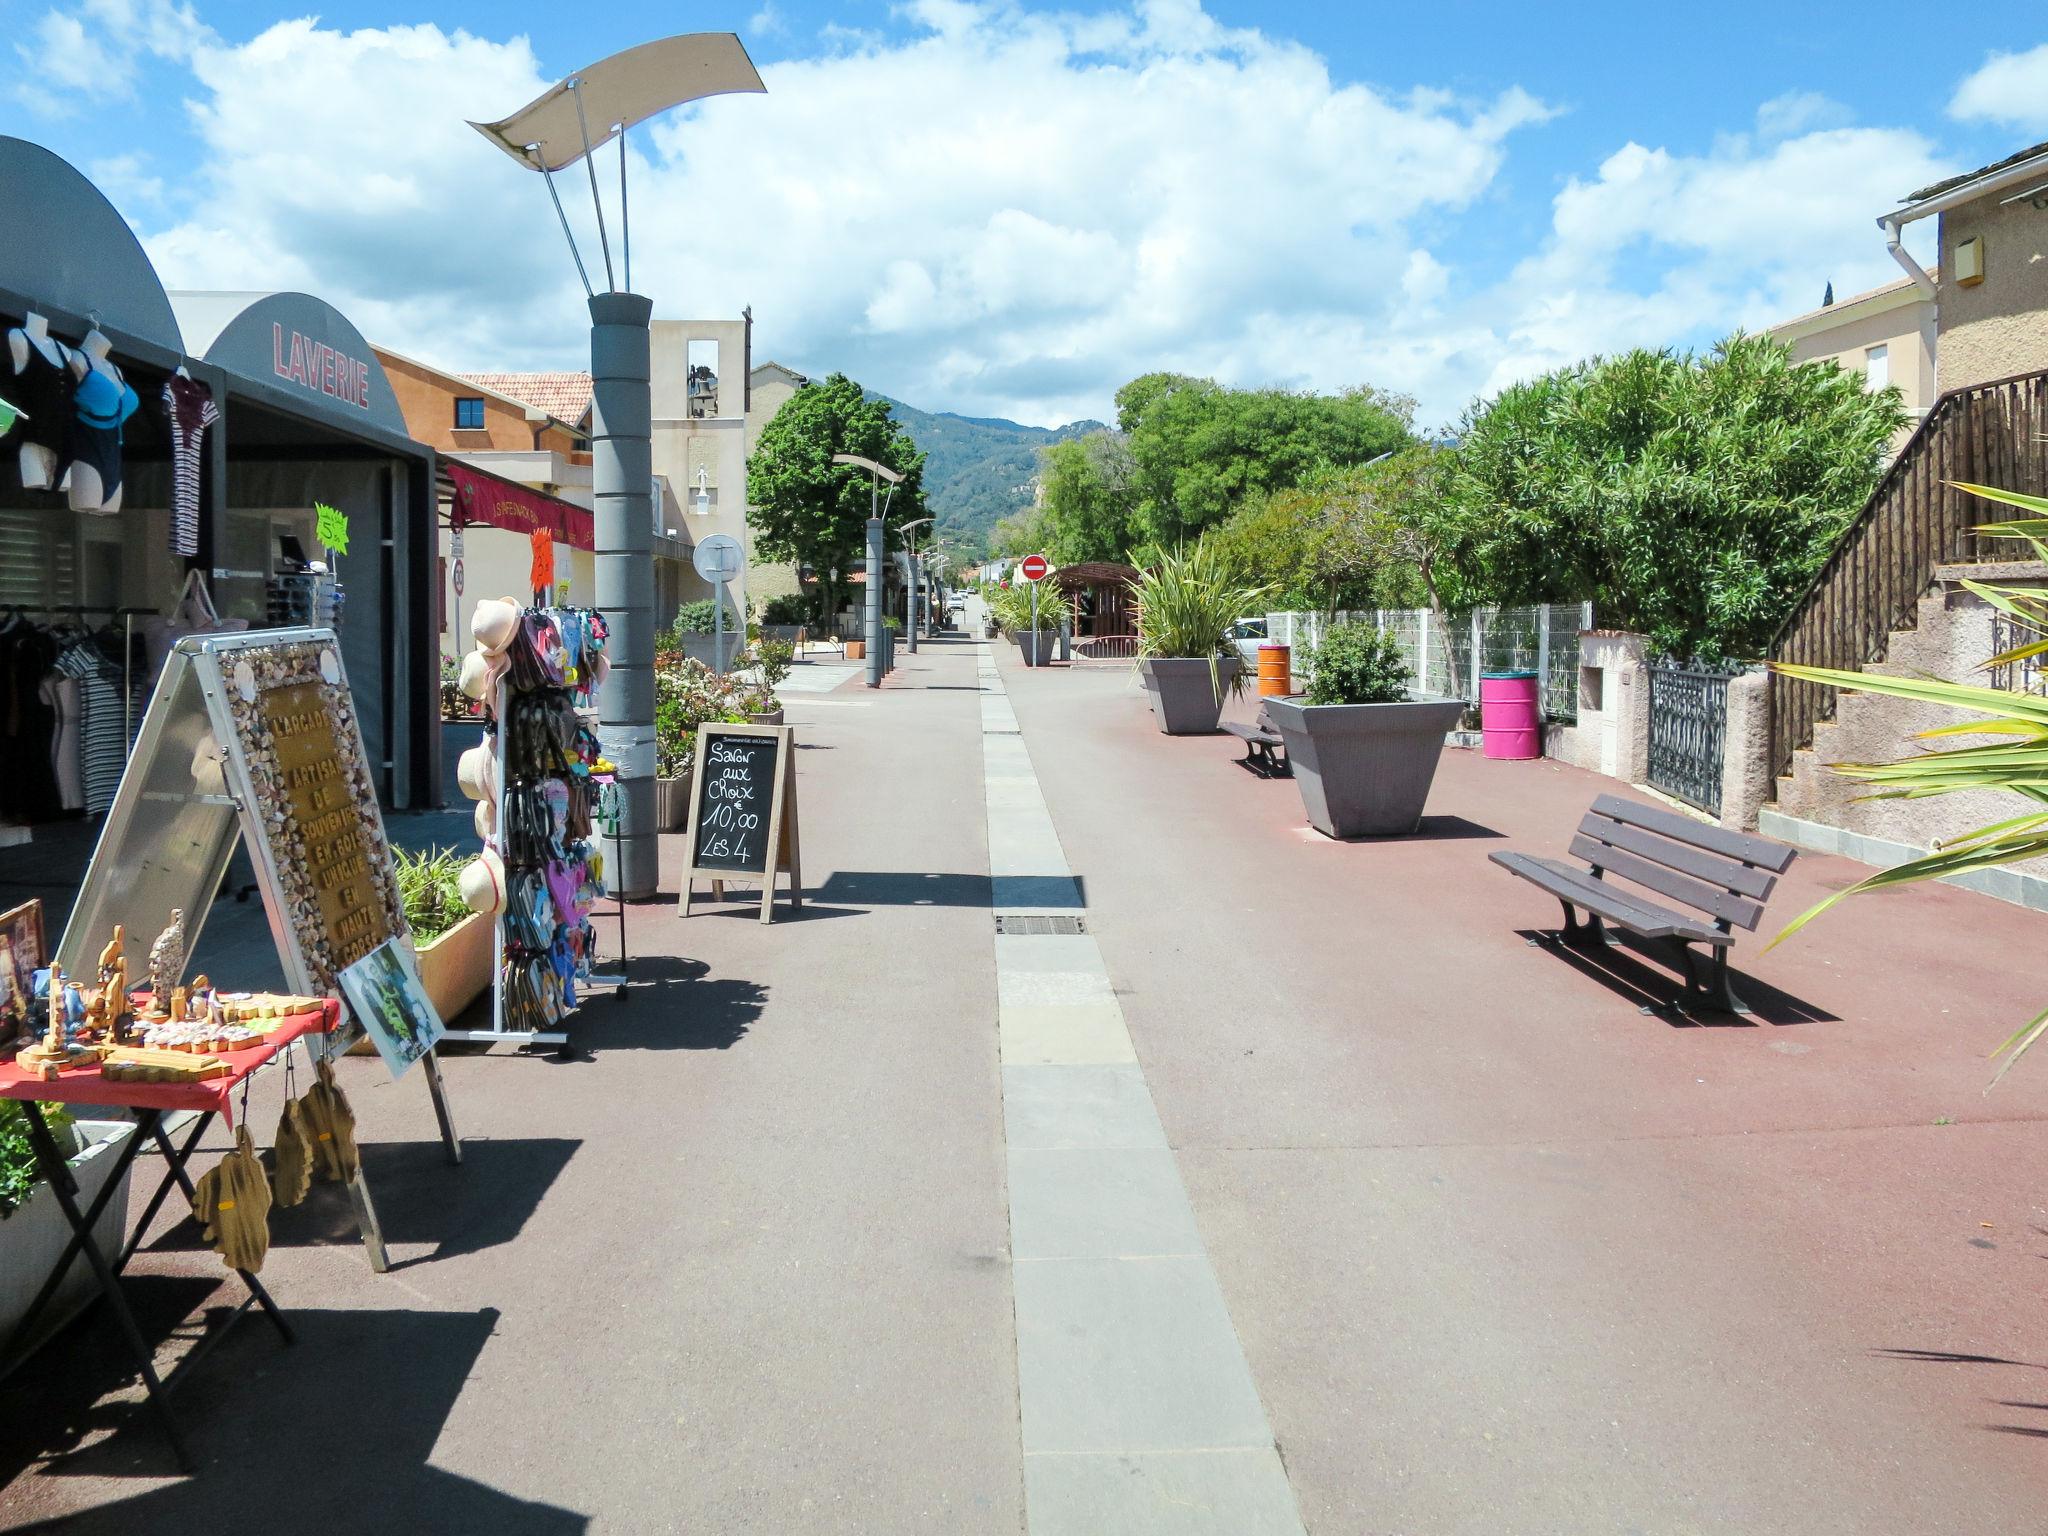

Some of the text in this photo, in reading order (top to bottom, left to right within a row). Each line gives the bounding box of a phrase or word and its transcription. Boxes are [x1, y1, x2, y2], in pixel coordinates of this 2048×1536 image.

[273, 321, 369, 410] LAVERIE
[273, 709, 329, 736] L'ARCADE
[292, 758, 343, 788] ARTISAN
[722, 767, 752, 782] aux
[313, 787, 332, 810] DE
[708, 778, 755, 800] Choix
[702, 802, 759, 832] 10,00
[733, 833, 751, 864] 4
[322, 855, 366, 889] UNIQUE
[342, 887, 360, 908] EN
[340, 905, 377, 941] HAUTE
[343, 932, 379, 962] CORSE
